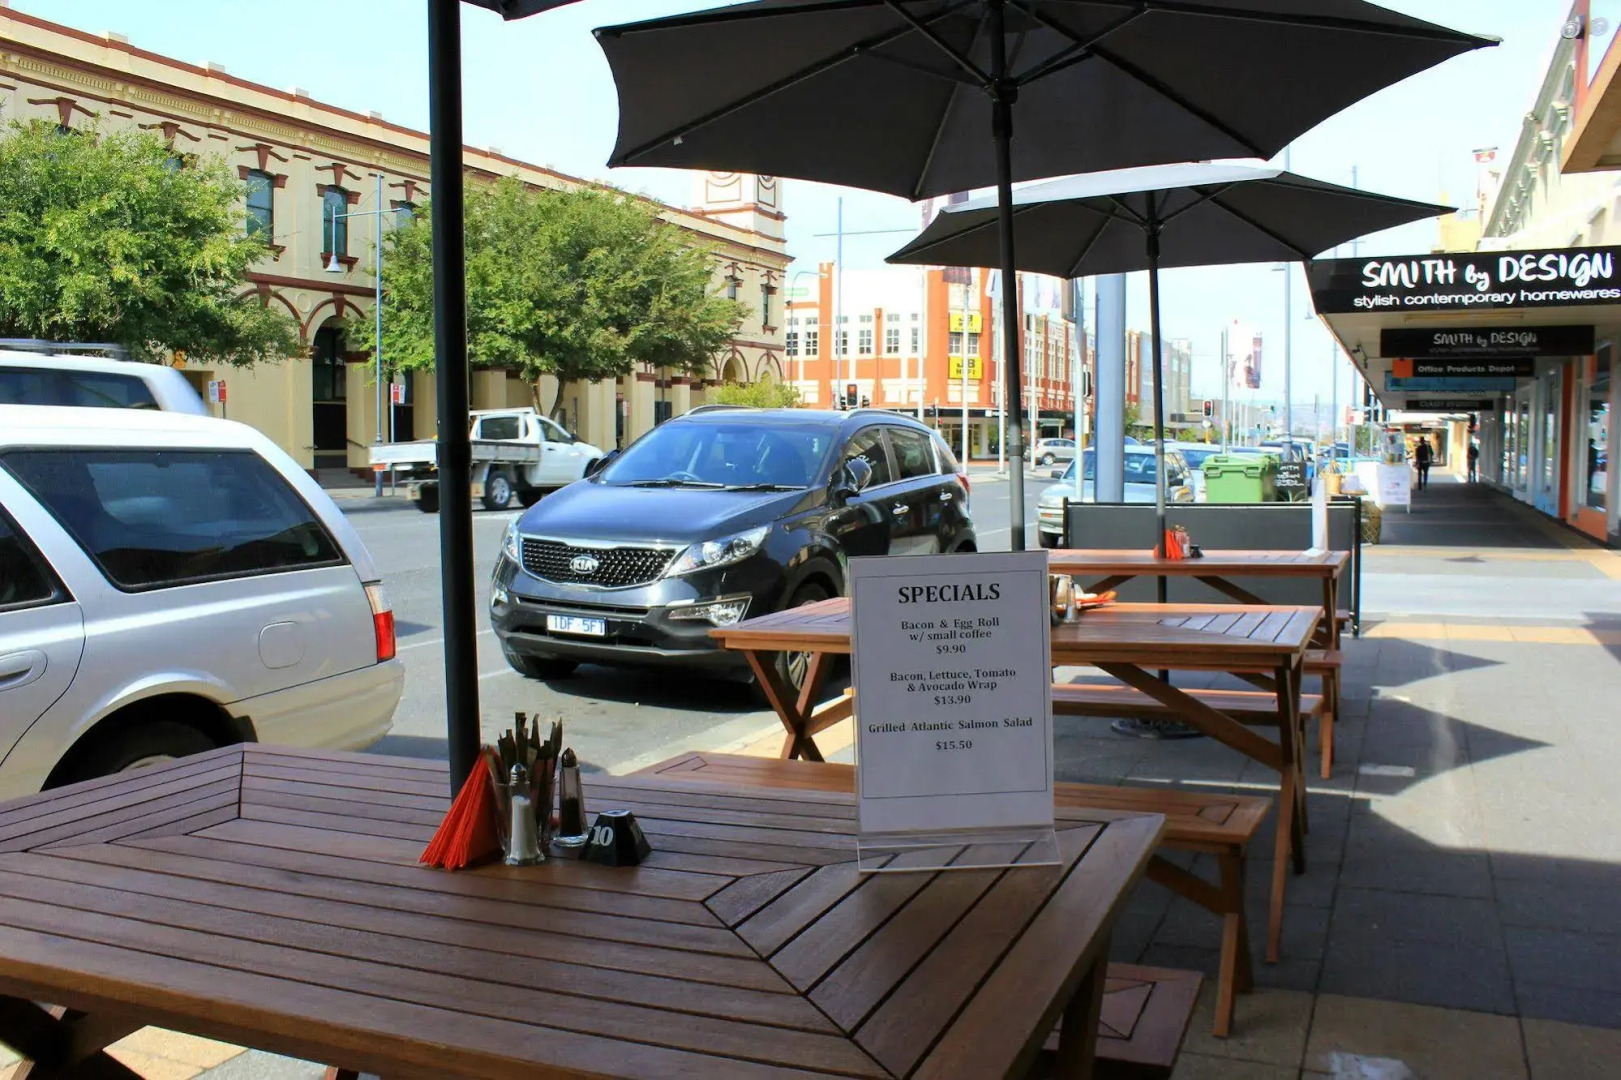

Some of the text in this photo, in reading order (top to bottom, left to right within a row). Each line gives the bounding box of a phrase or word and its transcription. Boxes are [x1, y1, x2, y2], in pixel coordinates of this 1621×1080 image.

[1361, 252, 1613, 292] SMITH by DESIGN
[1354, 288, 1621, 309] stylish contemporary homewares
[1433, 331, 1538, 348] SMITH by DESIGN
[1418, 365, 1444, 373] Office
[1446, 365, 1486, 373] Products
[1488, 365, 1515, 374] Depot
[573, 559, 593, 571] KIA
[898, 583, 1000, 604] SPECIALS
[901, 617, 1000, 630] Bacon & Egg Roll
[909, 629, 992, 643] w/ small coffee
[936, 644, 966, 655] $9.90
[890, 668, 1016, 682] Bacon, Lettuce, Tomato
[907, 680, 998, 692] & Avocado Wrap
[934, 694, 971, 705] $13.90
[868, 717, 1033, 733] Grilled Atlantic Salmon Salad
[935, 740, 973, 751] $15.50
[591, 825, 614, 847] 10
